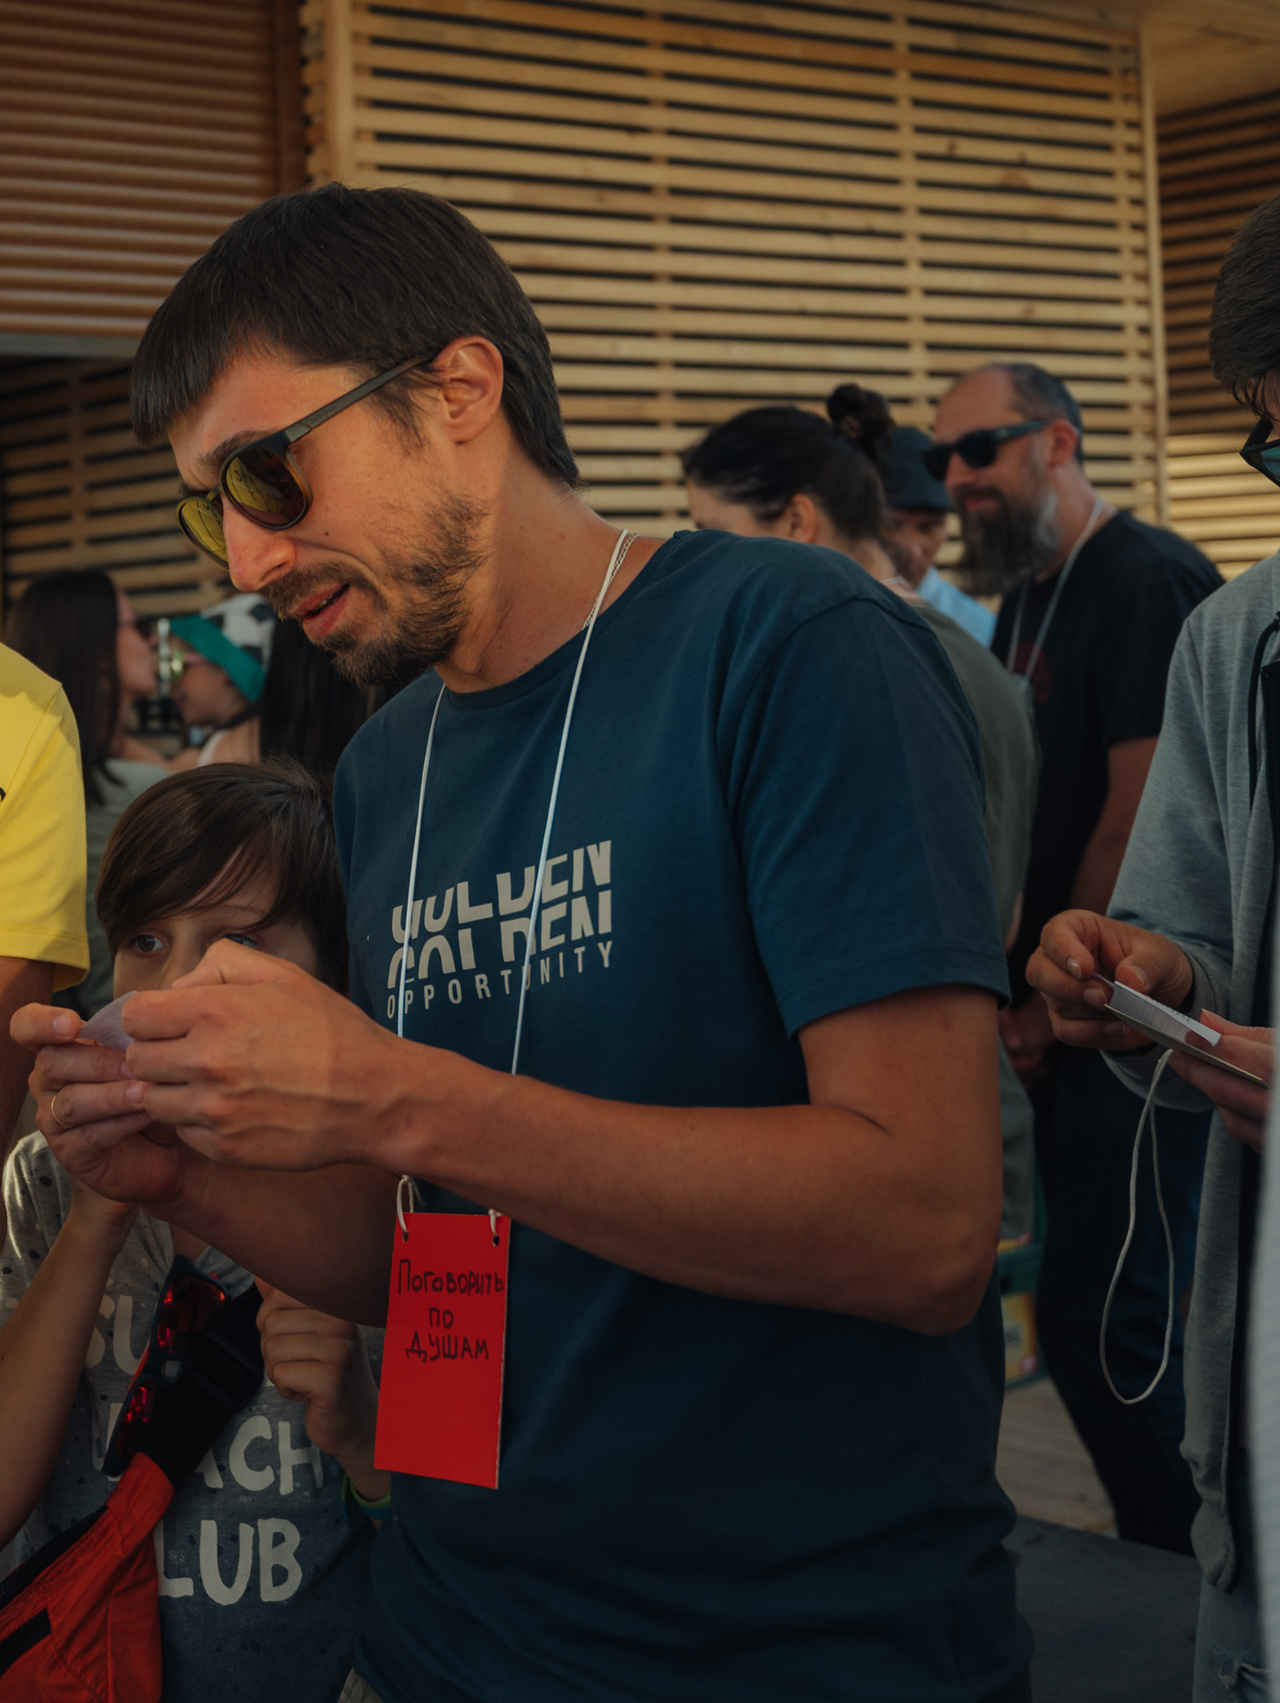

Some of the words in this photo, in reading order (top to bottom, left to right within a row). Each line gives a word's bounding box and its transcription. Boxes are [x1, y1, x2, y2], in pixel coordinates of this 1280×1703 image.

[387, 941, 612, 1019] OPPORTUNITY
[405, 1331, 489, 1363] ДУШАМ
[152, 1517, 303, 1606] LUB
